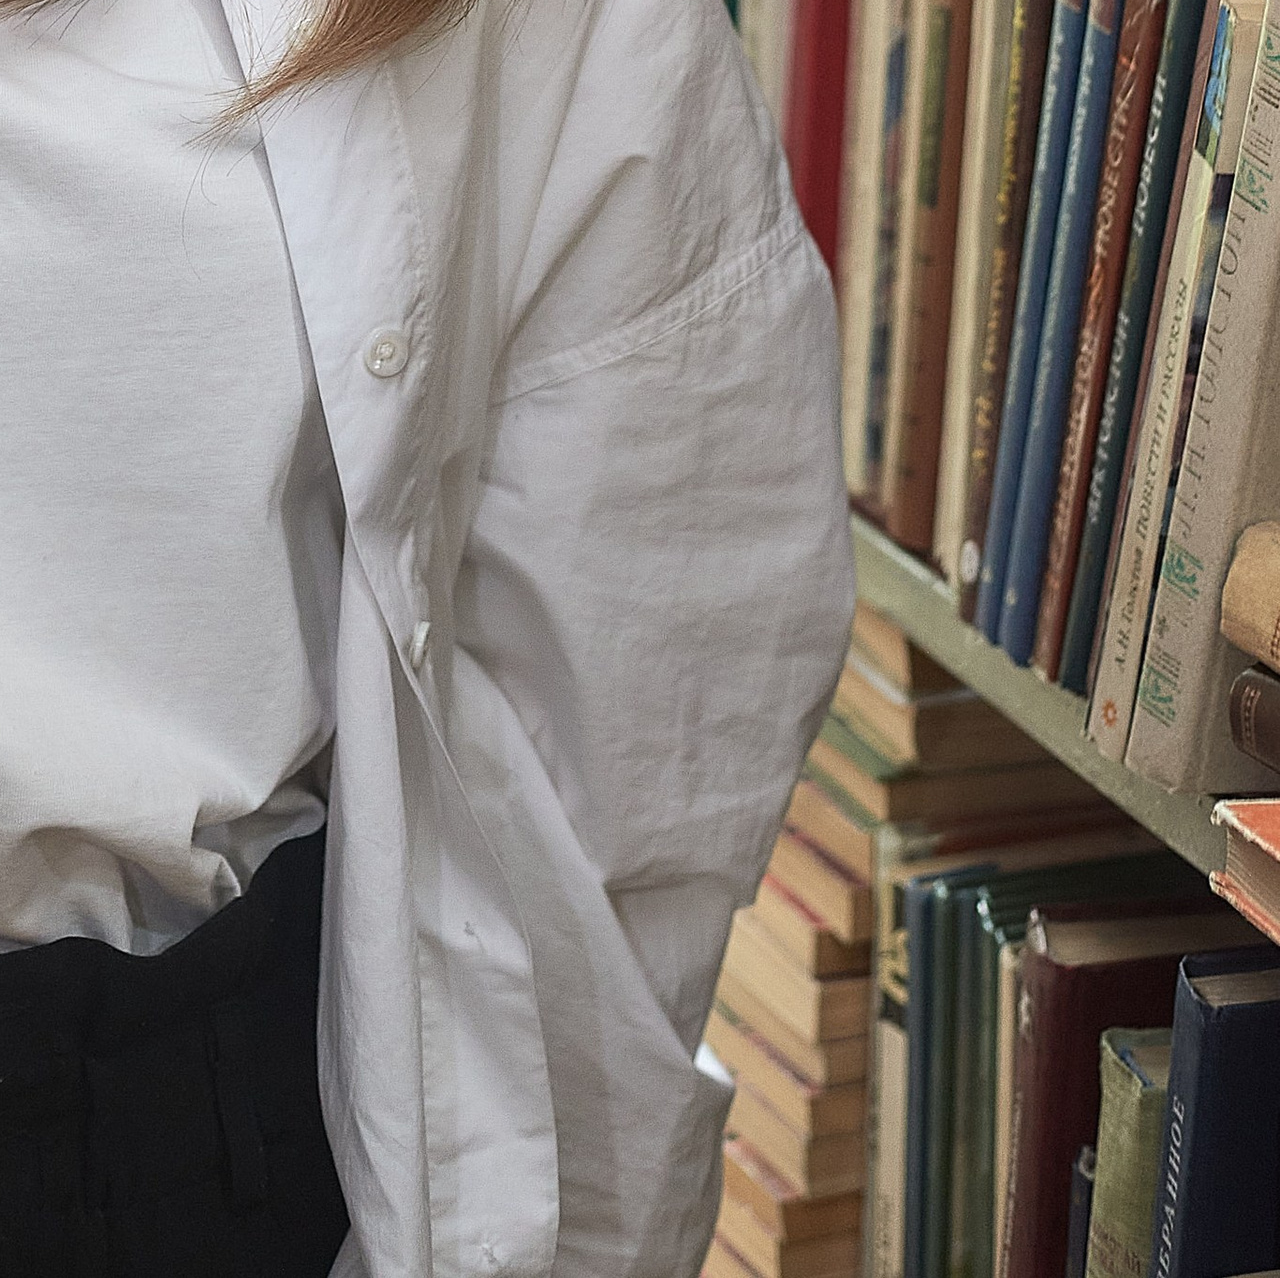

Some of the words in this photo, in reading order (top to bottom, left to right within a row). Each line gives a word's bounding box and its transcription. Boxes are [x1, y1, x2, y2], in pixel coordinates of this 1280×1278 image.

[1131, 73, 1167, 236] ПОВЕСТИ
[1135, 426, 1163, 540] ПОВЕСТИ
[1158, 1094, 1187, 1278] БРАННОЕ
